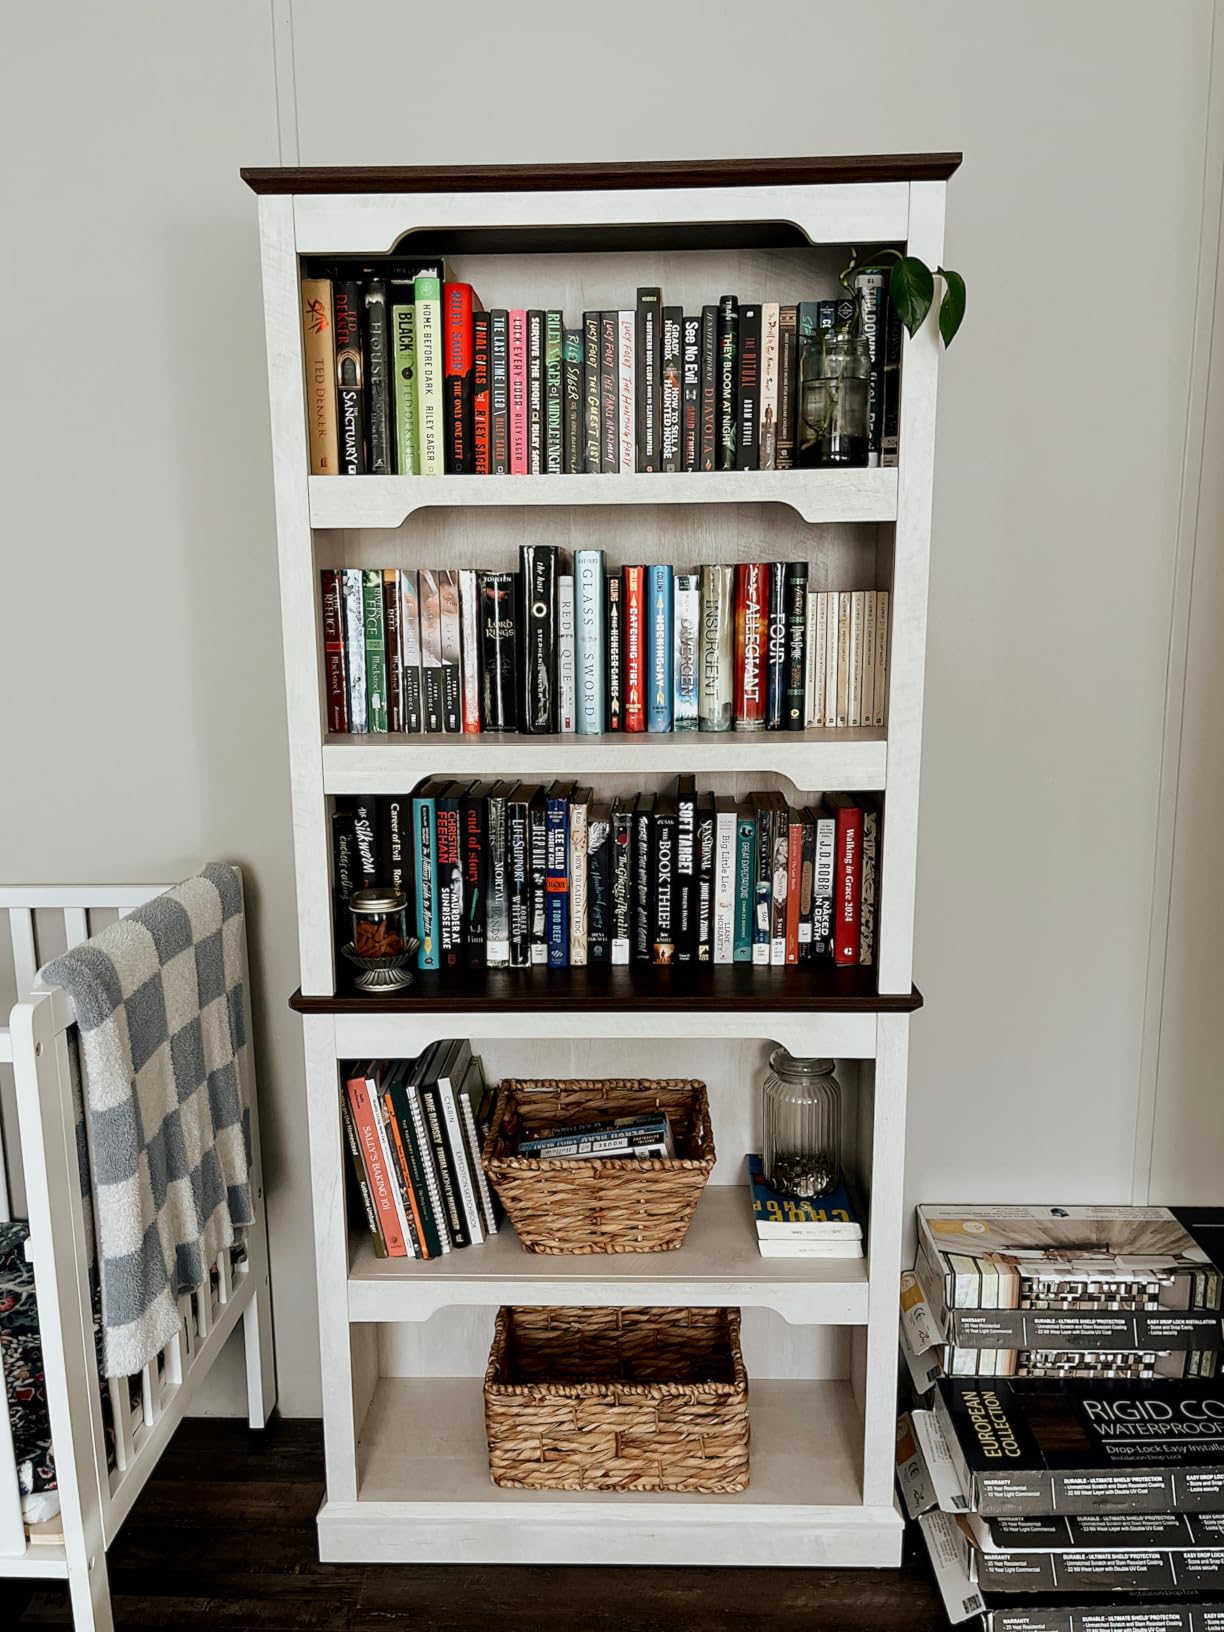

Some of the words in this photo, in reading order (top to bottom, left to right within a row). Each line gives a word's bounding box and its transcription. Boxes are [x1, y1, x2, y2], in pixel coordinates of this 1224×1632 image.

[423, 304, 432, 329] HOME
[451, 291, 463, 327] RILEY
[724, 300, 732, 320] TRAN
[399, 313, 413, 352] BLACK
[493, 318, 504, 332] THE
[531, 317, 540, 357] SURVIVE
[547, 313, 560, 344] RILEY
[586, 320, 597, 341] LUCY
[603, 320, 615, 341] LUCY
[621, 321, 632, 342] LUCY
[685, 321, 698, 343] See
[371, 322, 381, 384] HOUSE
[423, 333, 432, 367] BEFORE
[452, 332, 463, 370] SAGER
[493, 336, 505, 356] LAST
[567, 335, 579, 363] RILEY
[664, 320, 673, 360] HENDRIX
[671, 324, 680, 356] GRADY
[723, 333, 732, 359] THEY
[531, 359, 540, 378] THE
[547, 347, 560, 386] SAGER
[586, 343, 598, 368] FOLEY
[604, 343, 615, 368] FOLEY
[623, 345, 632, 368] FOLEY
[425, 370, 434, 395] DARK
[494, 361, 505, 379] TIME
[567, 367, 579, 400] SAGER
[589, 376, 597, 392] THE
[684, 363, 698, 384] Evil
[722, 361, 732, 398] BLOOM
[453, 381, 462, 396] THE
[494, 391, 505, 408] LIED
[531, 381, 540, 410] NIGHT
[671, 387, 679, 409] HOW
[454, 400, 462, 418] ONLY
[588, 396, 599, 437] GUEST
[663, 380, 672, 426] HAUNTED
[343, 392, 357, 463] SANCTUARY
[425, 406, 434, 430] RILEY
[454, 421, 463, 437] ONE
[496, 418, 505, 436] RILEY
[703, 387, 714, 453] DIAVOLA
[722, 415, 731, 447] NIGHT
[426, 434, 435, 461] SAGER
[454, 440, 463, 460] LEFT
[496, 439, 505, 460] SAGER
[588, 440, 599, 464] LIST
[664, 427, 672, 459] HOUSE
[536, 562, 545, 575] the
[536, 576, 545, 593] host
[582, 569, 593, 625] GLASS
[324, 594, 335, 636] REFUGE
[366, 600, 378, 635] EDGE
[704, 599, 719, 700] INSURGENT
[744, 600, 760, 703] ALLEGIANT
[770, 613, 785, 664] FOUR
[584, 653, 595, 716] SWORD
[467, 810, 481, 833] end
[512, 819, 524, 840] LIFE
[679, 802, 693, 830] SOFT
[437, 811, 447, 864] FEEHAN
[447, 811, 458, 864] CHRISTINE
[532, 826, 545, 845] DEEP
[555, 829, 564, 844] LEE
[721, 835, 730, 849] Big
[844, 828, 855, 864] Walking
[512, 840, 524, 883] SUPPORT
[532, 849, 545, 869] BLUE
[555, 846, 564, 869] CHILD
[658, 841, 671, 883] BOOK
[678, 833, 693, 875] TARGET
[721, 851, 730, 874] Little
[741, 842, 750, 859] GREAT
[465, 852, 481, 884] story
[740, 860, 750, 898] EXPECTATIONS
[495, 862, 503, 904] MORTAL
[721, 876, 729, 893] Lies
[845, 876, 854, 900] Grace
[441, 888, 451, 926] SUNRISE
[451, 893, 460, 932] MURDER
[512, 895, 521, 944] WHITLOW
[659, 885, 670, 929] THIEF
[822, 900, 830, 936] NAKED
[845, 902, 854, 922] 2024
[491, 906, 500, 940] BONDS
[552, 925, 560, 943] DEEP
[442, 928, 451, 949] LAKE
[424, 1093, 433, 1113] DAVE
[445, 1095, 454, 1123] CYARIN
[347, 1124, 359, 1156] Homestead
[428, 1113, 442, 1144] RAMSEY
[363, 1126, 376, 1162] SALLY'S
[372, 1162, 386, 1197] BAKING
[380, 1196, 390, 1210] 101
[360, 1181, 370, 1208] Katherine
[440, 1166, 450, 1197] MONEY
[447, 1197, 459, 1230] MAKEOVER
[455, 1151, 469, 1187] EXPEDITION
[463, 1187, 476, 1230] SKETCHBOOK
[364, 1208, 376, 1233] Umbarger
[961, 1391, 1002, 1457] EUROPEAN
[981, 1391, 1021, 1457] COLLECTION
[1083, 1400, 1172, 1420] RIGID
[1106, 1445, 1163, 1454] Drop-Lock
[1164, 1445, 1187, 1453] Easy
